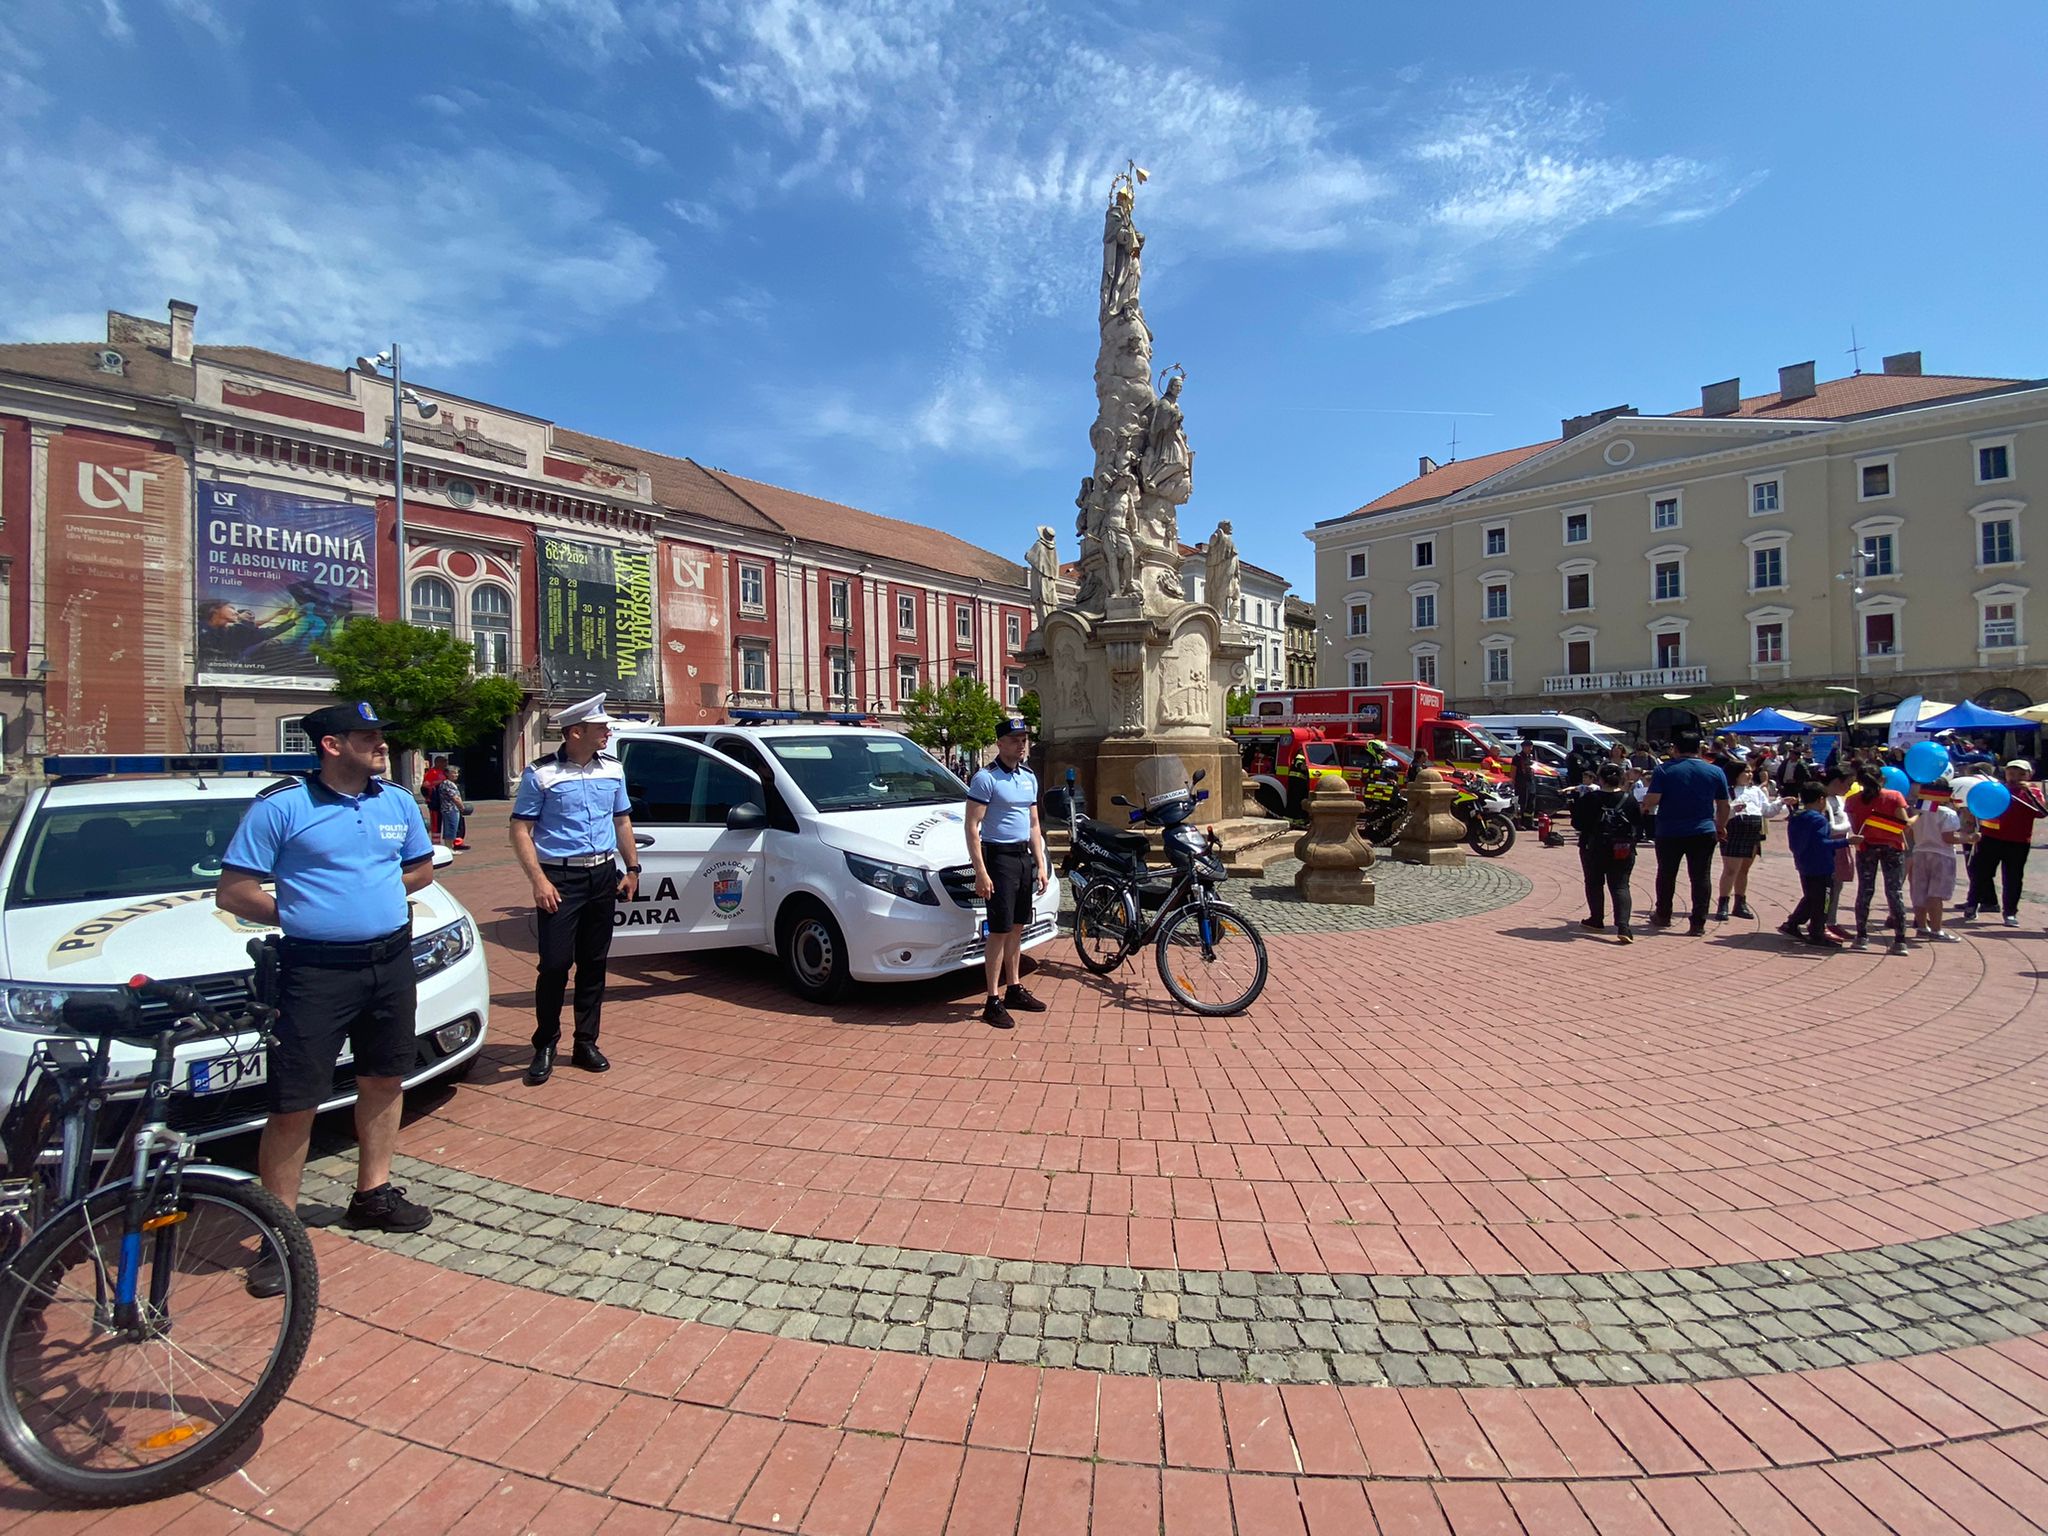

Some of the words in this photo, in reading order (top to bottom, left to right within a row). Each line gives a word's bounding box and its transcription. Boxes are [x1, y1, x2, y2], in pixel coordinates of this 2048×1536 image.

[65, 524, 131, 539] Universitatea
[209, 519, 366, 564] CEREMONIA
[546, 548, 565, 561] OCT
[567, 552, 588, 565] 2021
[209, 550, 228, 564] DE
[232, 552, 309, 573] ABSOLVIRE
[313, 561, 369, 590] 2021
[612, 549, 638, 598] JAZZ
[209, 576, 220, 585] 17
[221, 578, 243, 587] iulie
[548, 577, 560, 586] 28
[567, 578, 578, 588] 29
[582, 604, 593, 613] 30
[598, 605, 606, 615] 31
[615, 597, 638, 680] FESTIVAL
[217, 1054, 262, 1084] TM
